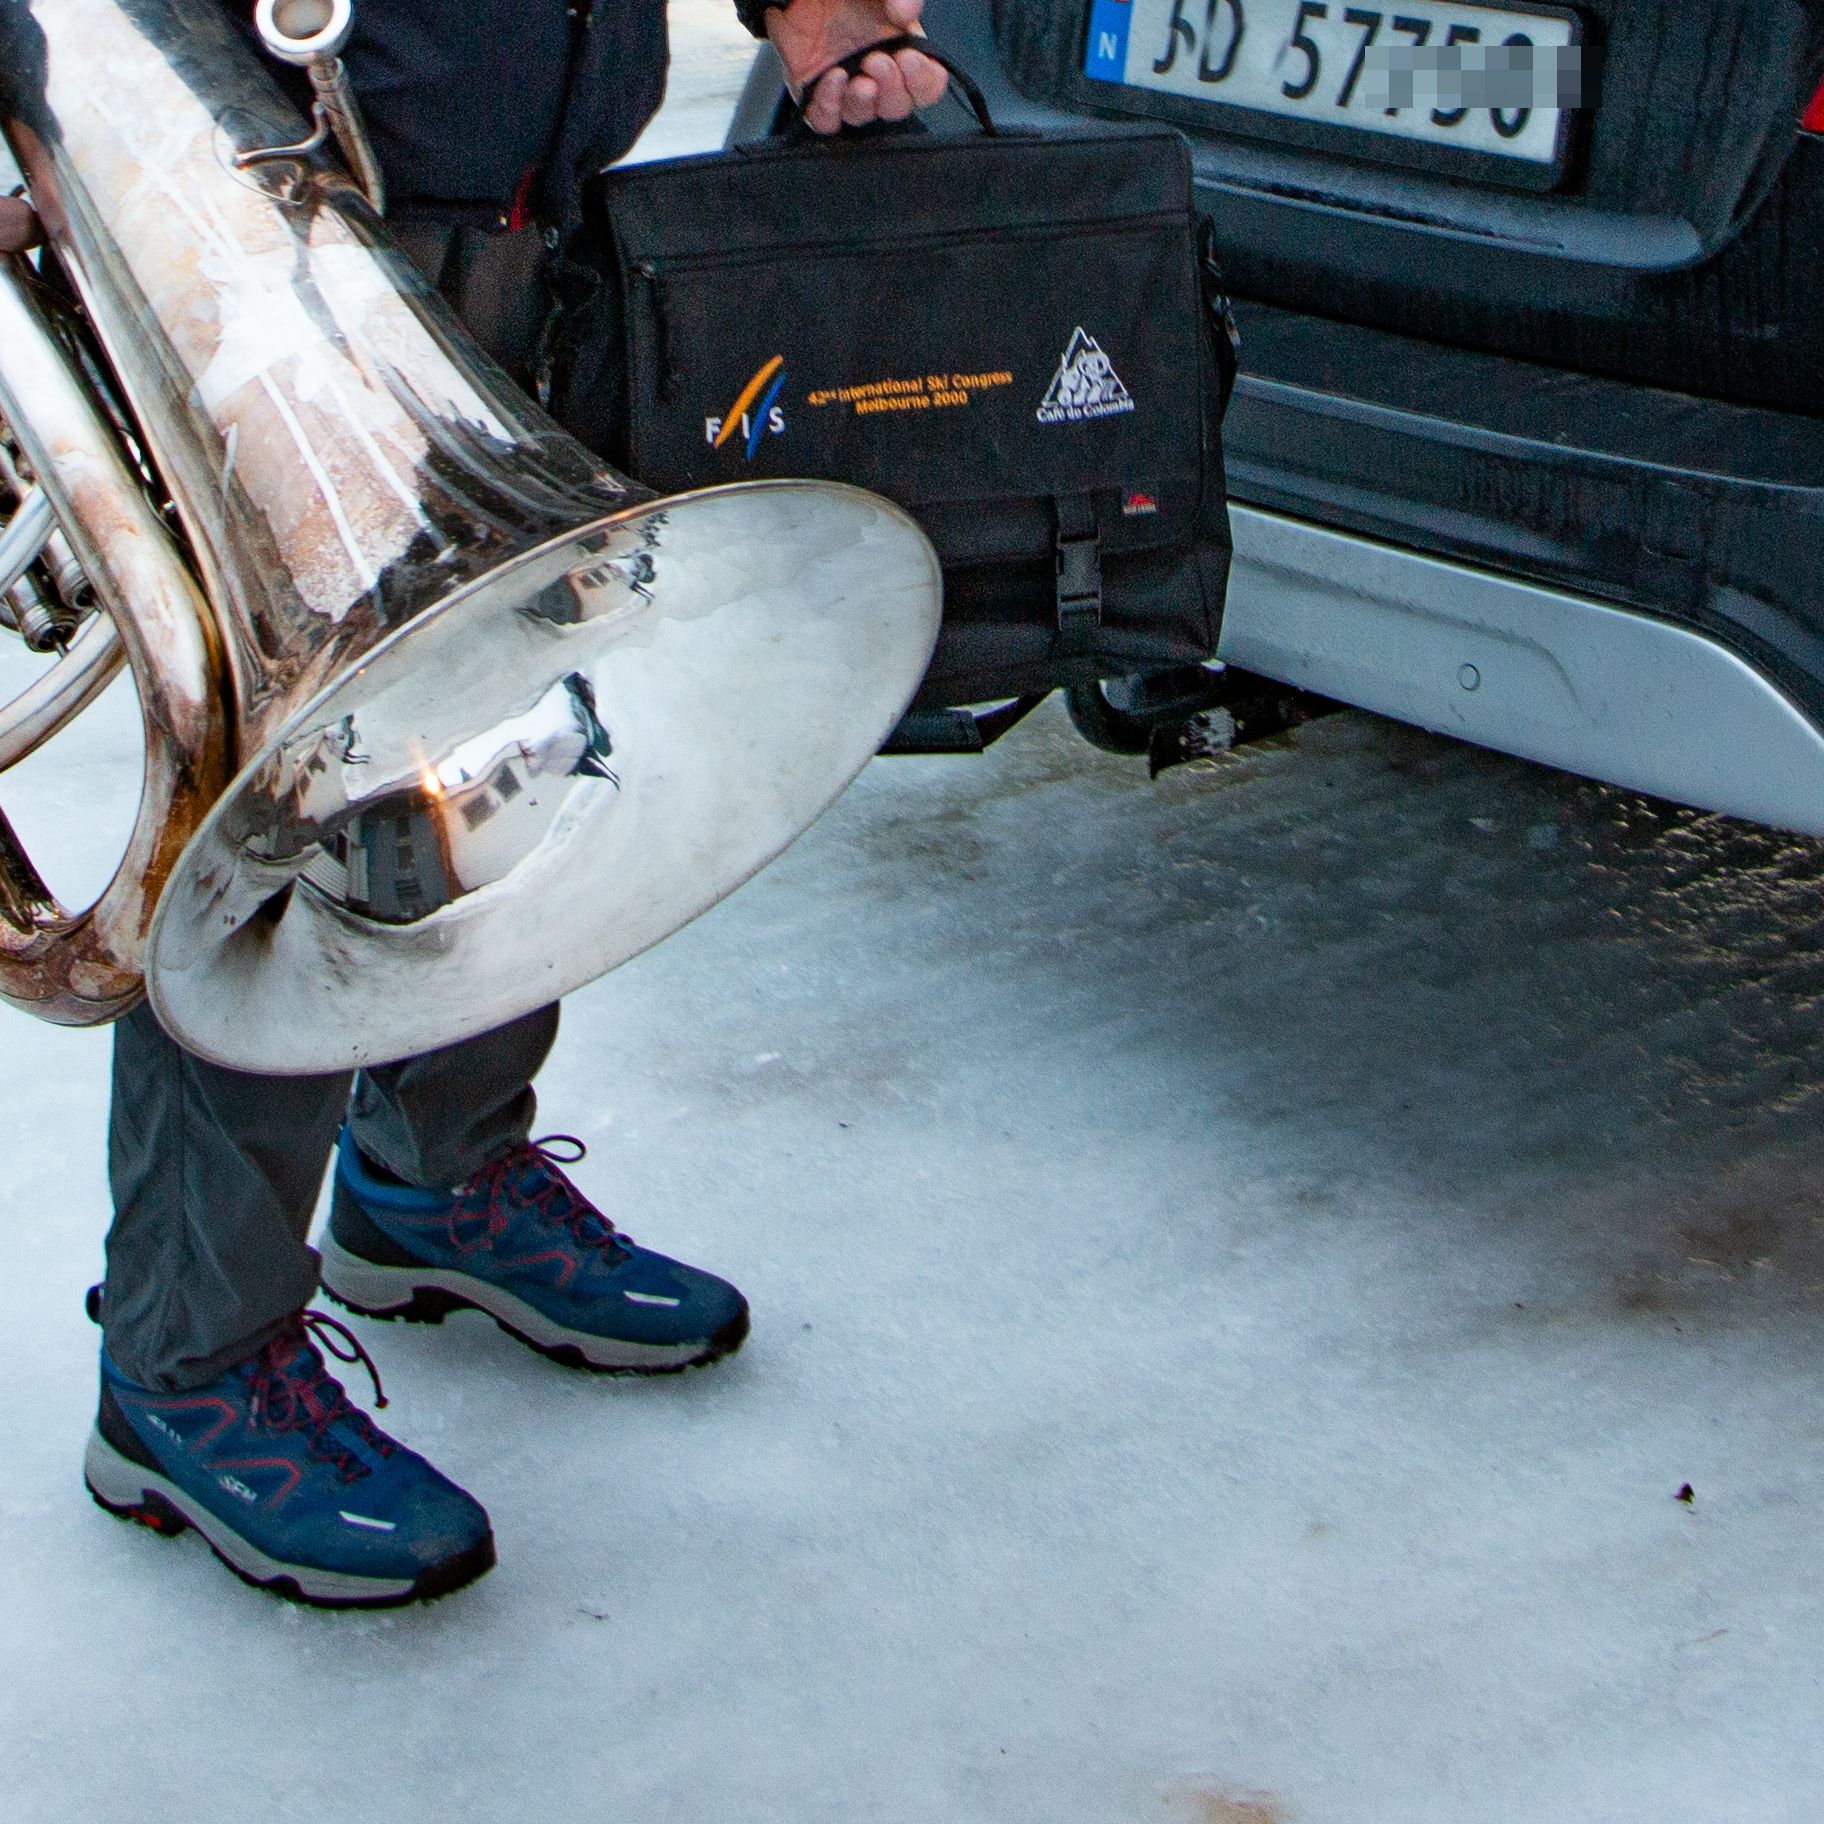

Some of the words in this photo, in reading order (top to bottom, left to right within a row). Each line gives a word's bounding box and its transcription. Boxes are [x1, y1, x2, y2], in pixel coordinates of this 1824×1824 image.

[1098, 30, 1118, 60] N
[926, 374, 949, 391] Ski
[951, 371, 1014, 389] Congress
[855, 394, 930, 415] Melbourne
[1083, 397, 1135, 418] Colombia
